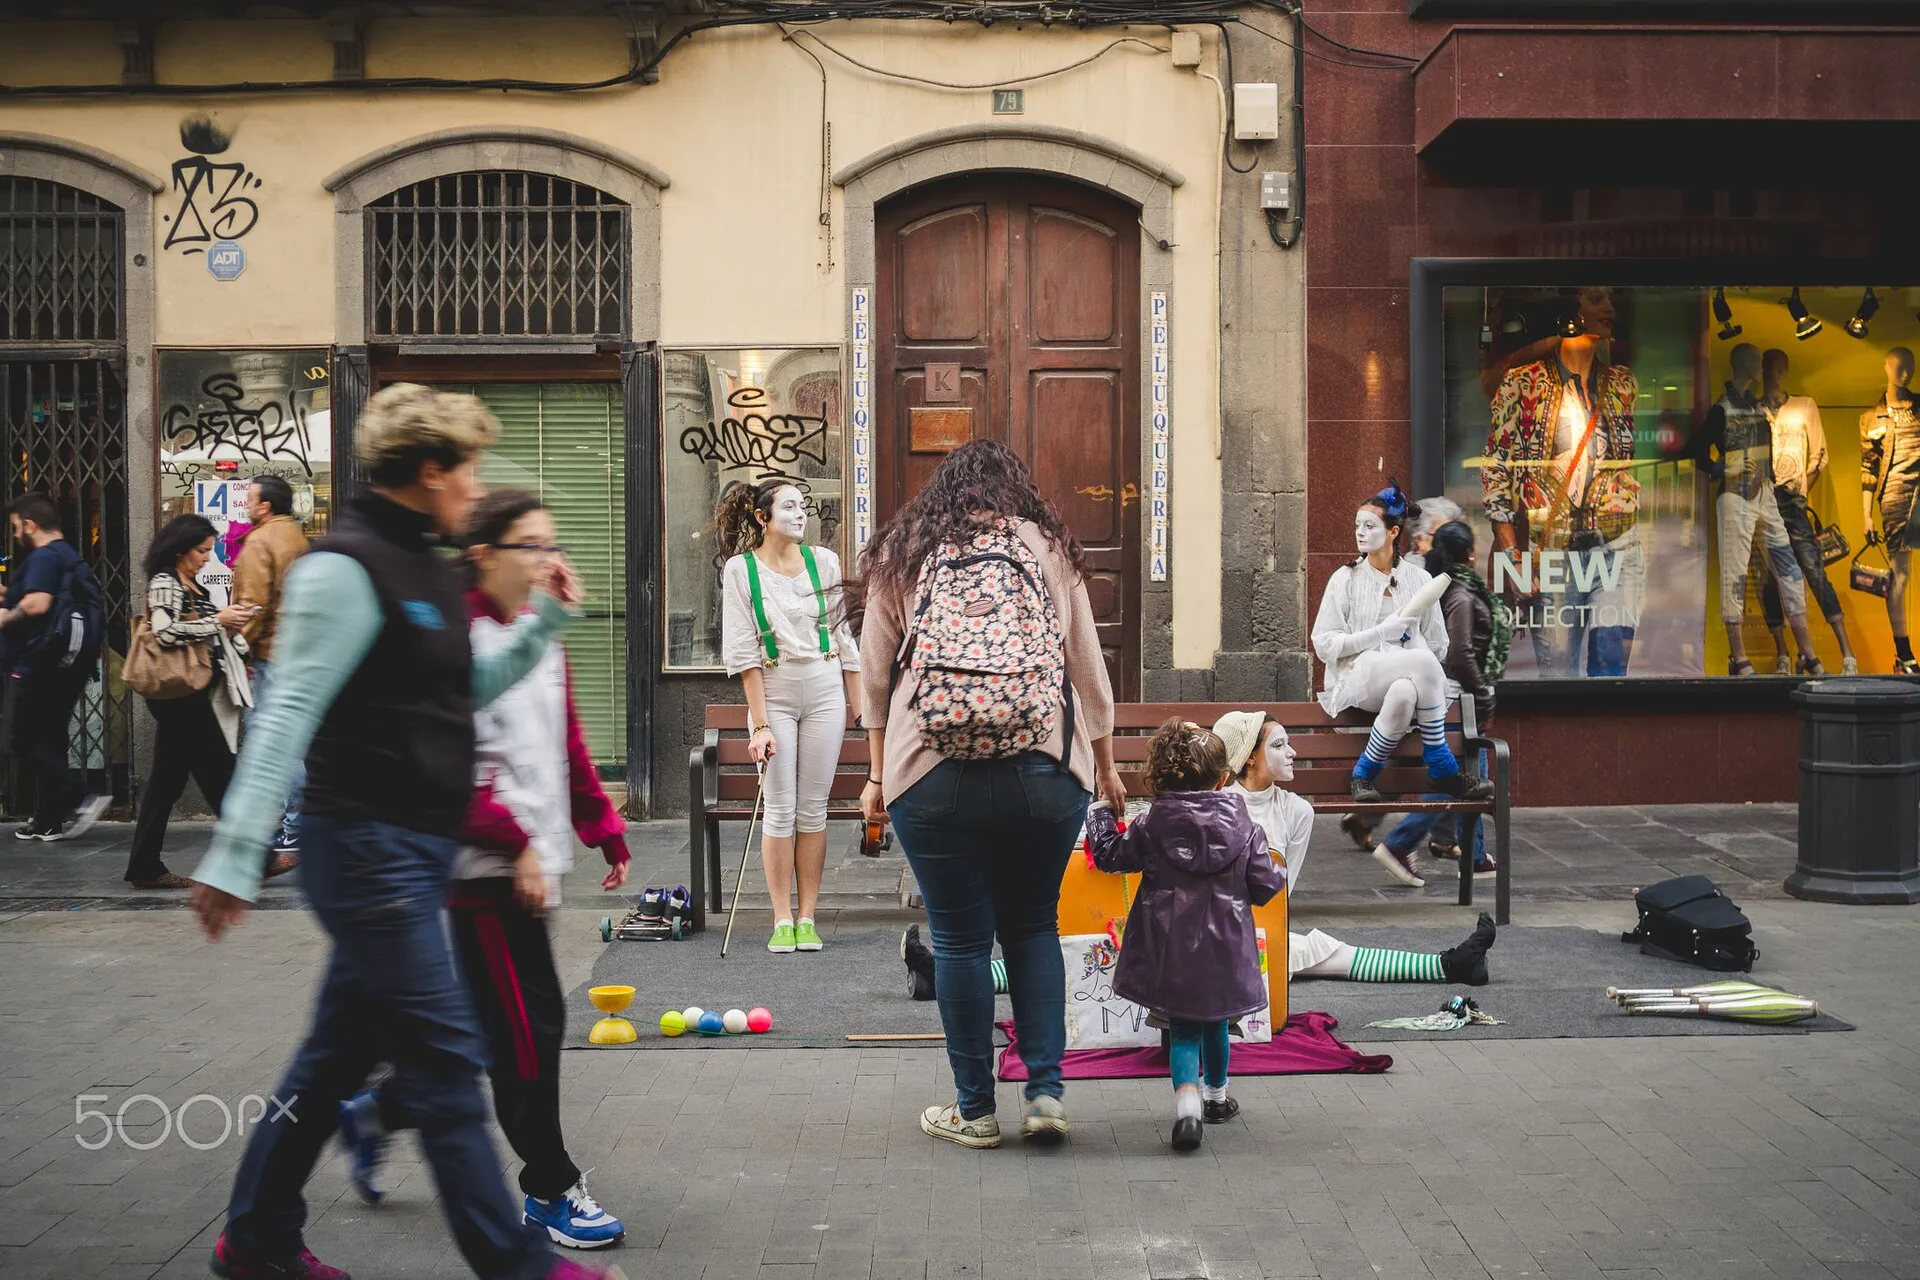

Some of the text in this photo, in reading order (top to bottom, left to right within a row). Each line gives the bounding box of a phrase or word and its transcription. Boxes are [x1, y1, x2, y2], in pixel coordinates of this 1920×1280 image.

[213, 251, 240, 265] ADT
[934, 370, 953, 391] K
[854, 294, 869, 543] PELUQUERI
[1152, 298, 1168, 575] PELUQUERIA
[197, 483, 228, 515] 14
[1493, 550, 1625, 594] NEW
